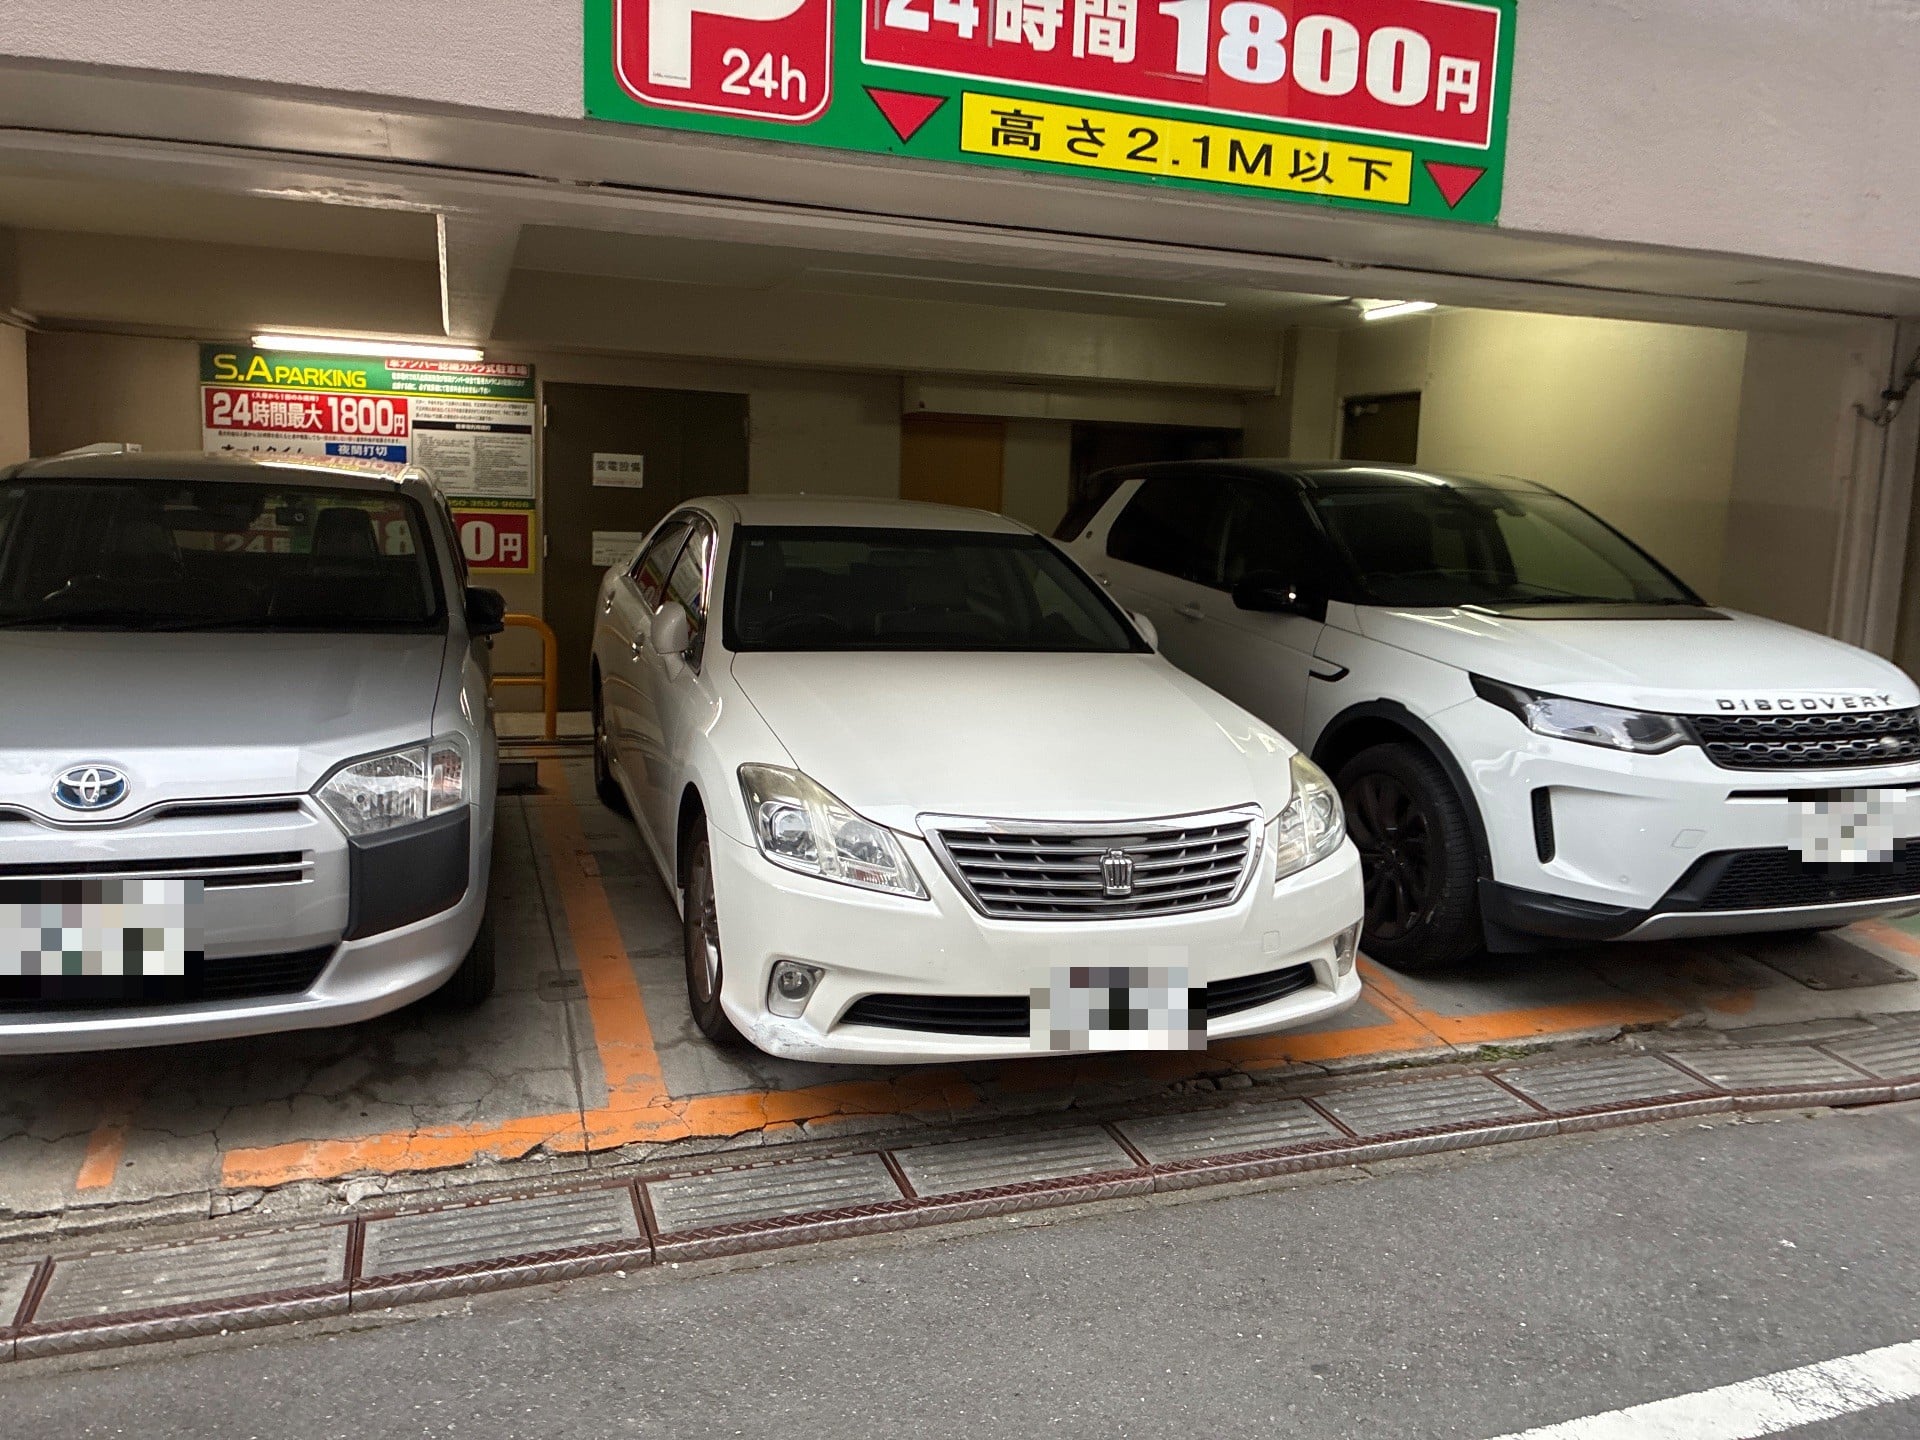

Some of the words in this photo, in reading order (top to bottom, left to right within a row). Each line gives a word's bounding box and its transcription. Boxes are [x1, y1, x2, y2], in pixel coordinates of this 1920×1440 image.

[722, 48, 806, 103] 24h
[1158, 0, 1481, 114] 1800円
[990, 109, 1392, 191] 高さ2.1M以下
[213, 353, 273, 382] S.A
[275, 366, 367, 388] PARKING
[212, 392, 323, 429] 24時間最大
[327, 396, 406, 435] 1800円
[338, 444, 388, 457] 夜間打切
[1716, 694, 1893, 711] DISCOVERY
